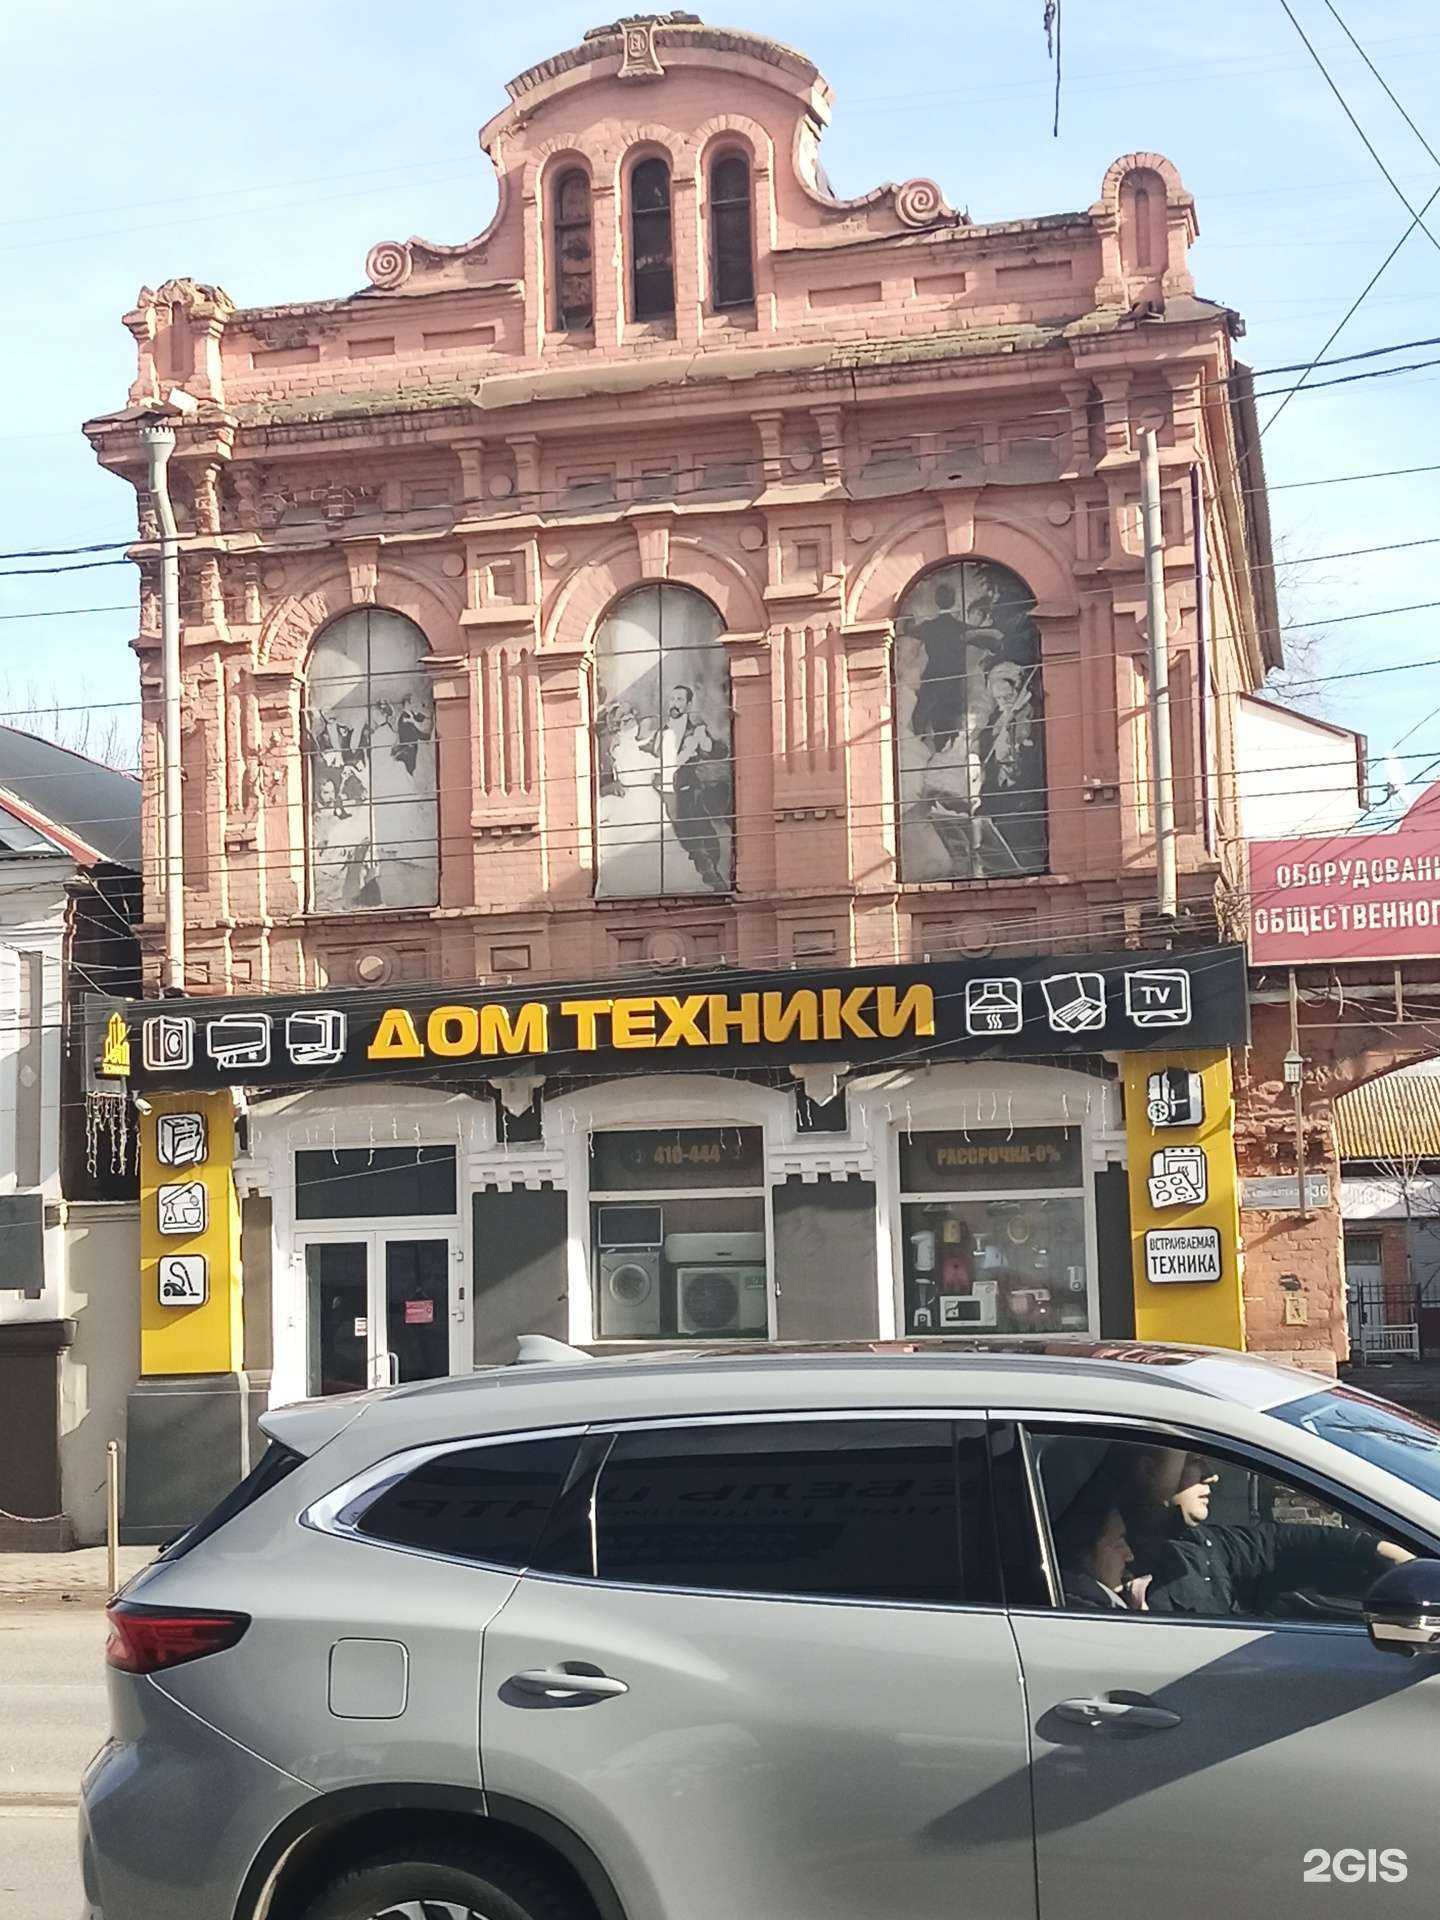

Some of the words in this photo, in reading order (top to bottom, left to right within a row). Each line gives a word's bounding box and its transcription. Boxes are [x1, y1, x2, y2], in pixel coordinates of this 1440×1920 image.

[1141, 986, 1170, 1004] TV
[367, 1002, 548, 1060] ДОМ
[560, 983, 936, 1052] ТЕХНИКИ
[1149, 1235, 1216, 1250] ВСТРАИВАЕМАЯ
[1150, 1254, 1217, 1275] ТЕХНИКА
